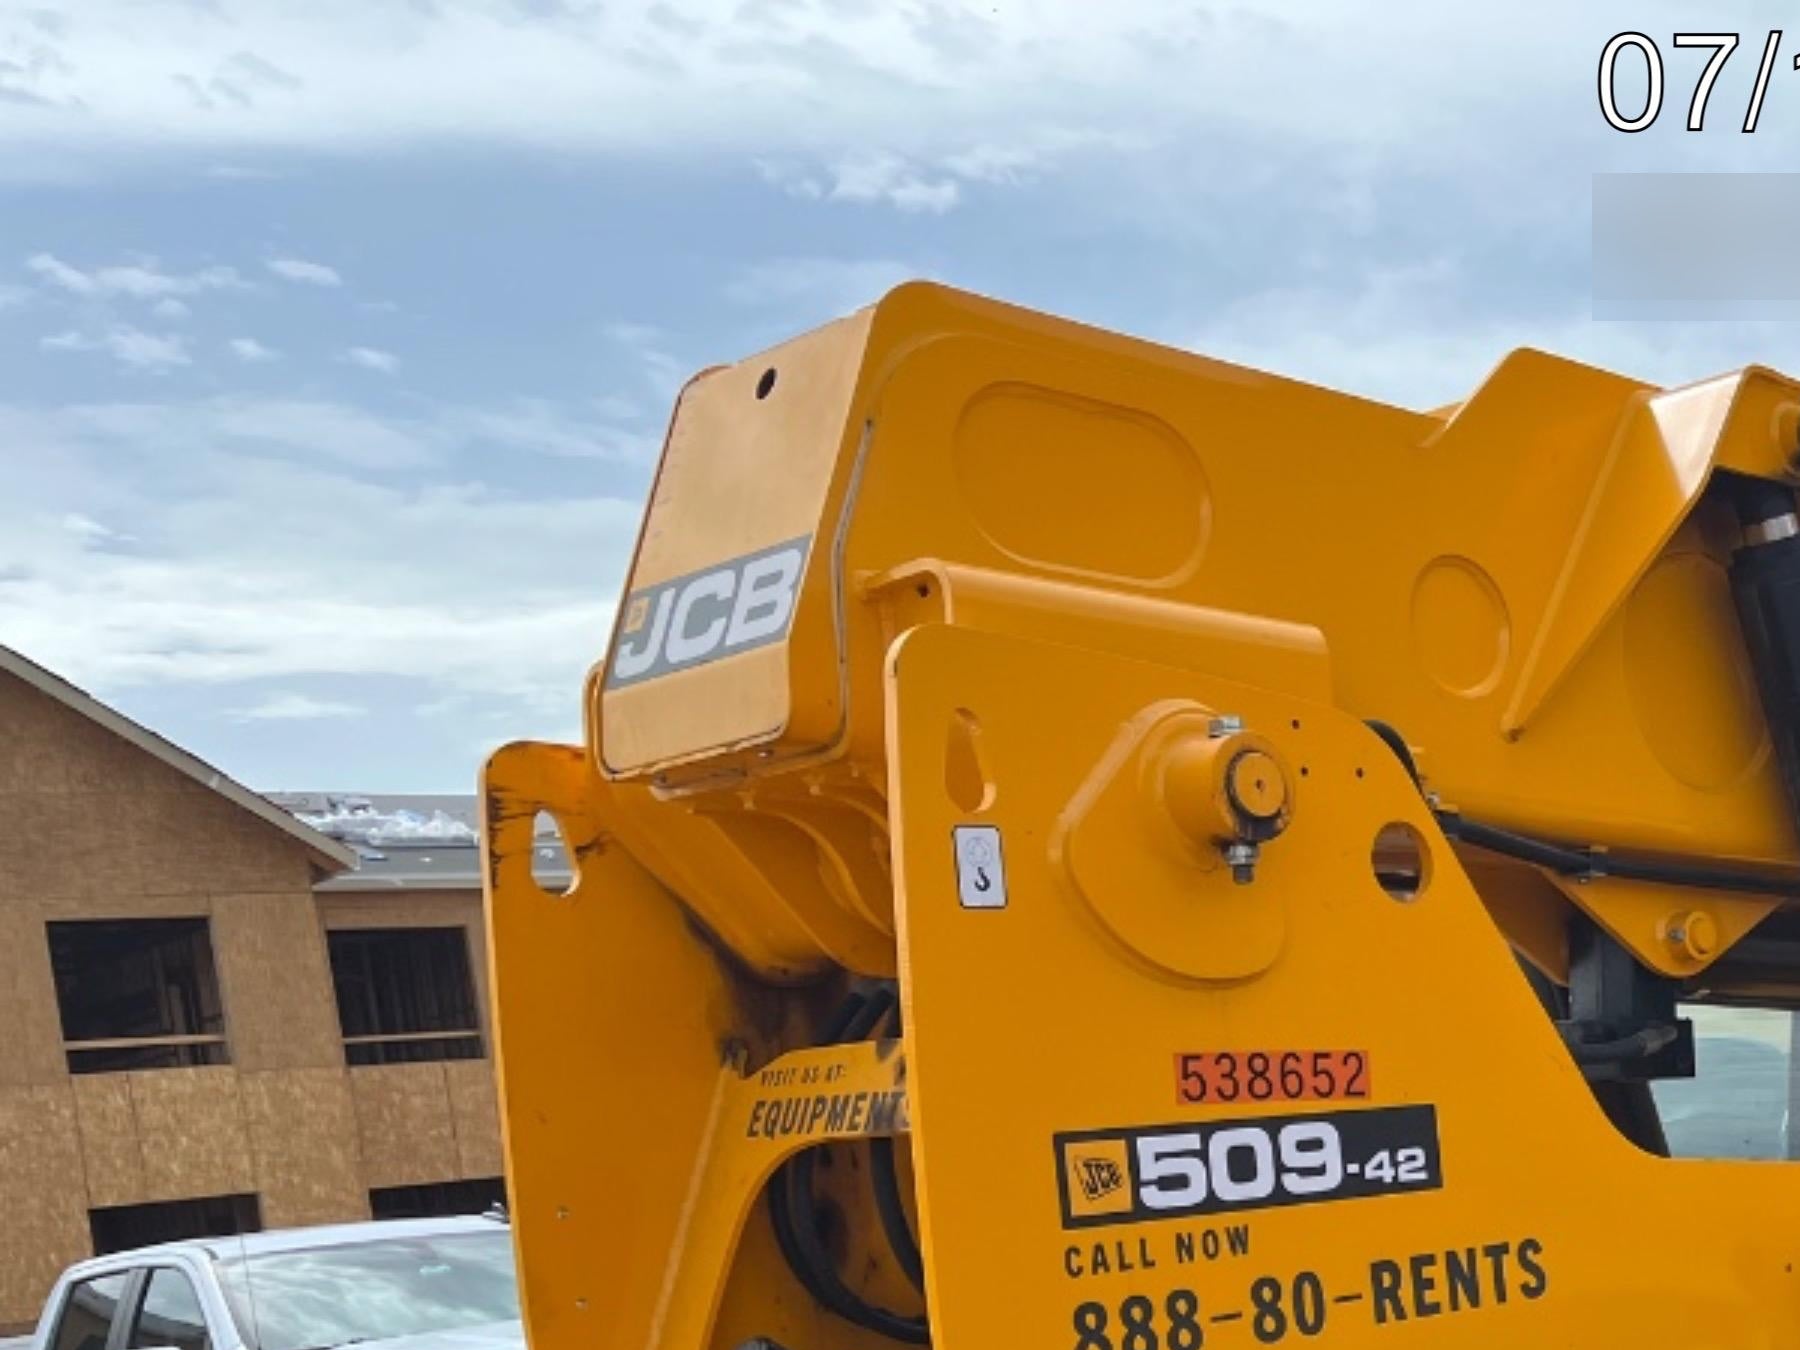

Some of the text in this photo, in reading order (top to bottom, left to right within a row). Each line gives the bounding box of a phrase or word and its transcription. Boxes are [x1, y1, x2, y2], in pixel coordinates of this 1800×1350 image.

[614, 549, 802, 679] JCB
[1180, 1052, 1366, 1101] 538652
[1136, 1120, 1428, 1210] 509-42
[1064, 1224, 1250, 1278] CALL NOW
